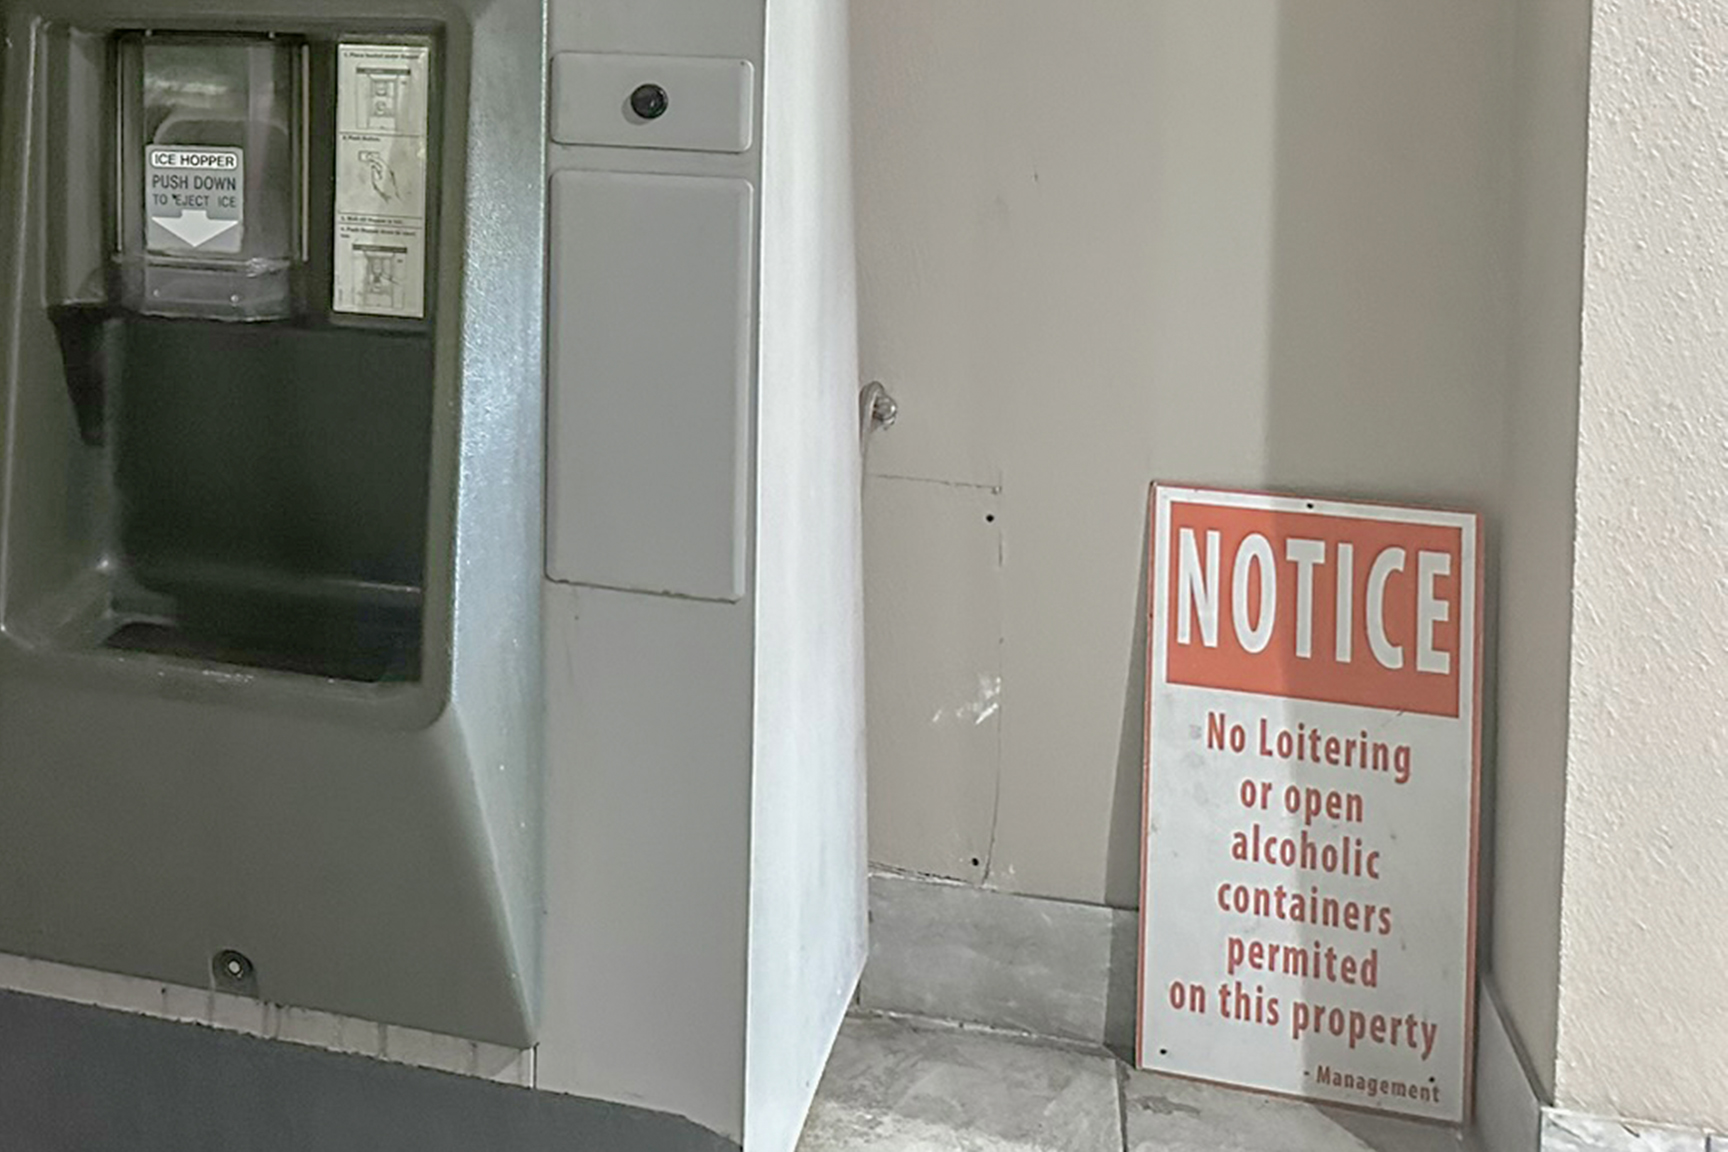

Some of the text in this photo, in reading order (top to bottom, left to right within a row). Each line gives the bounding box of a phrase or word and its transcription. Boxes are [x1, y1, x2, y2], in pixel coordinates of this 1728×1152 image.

[152, 174, 236, 191] PUSH DOWN
[155, 152, 234, 167] ICE HOPPER
[153, 194, 236, 207] TO EJECT ICE
[1177, 528, 1451, 674] NOTICE
[1207, 712, 1411, 783] No Loitering
[1241, 779, 1363, 825] or open
[1232, 825, 1380, 879] alcoholic
[1218, 881, 1391, 936] containers
[1227, 936, 1377, 988] permited
[1170, 978, 1437, 1059] on this property
[1317, 1066, 1439, 1103] Management
